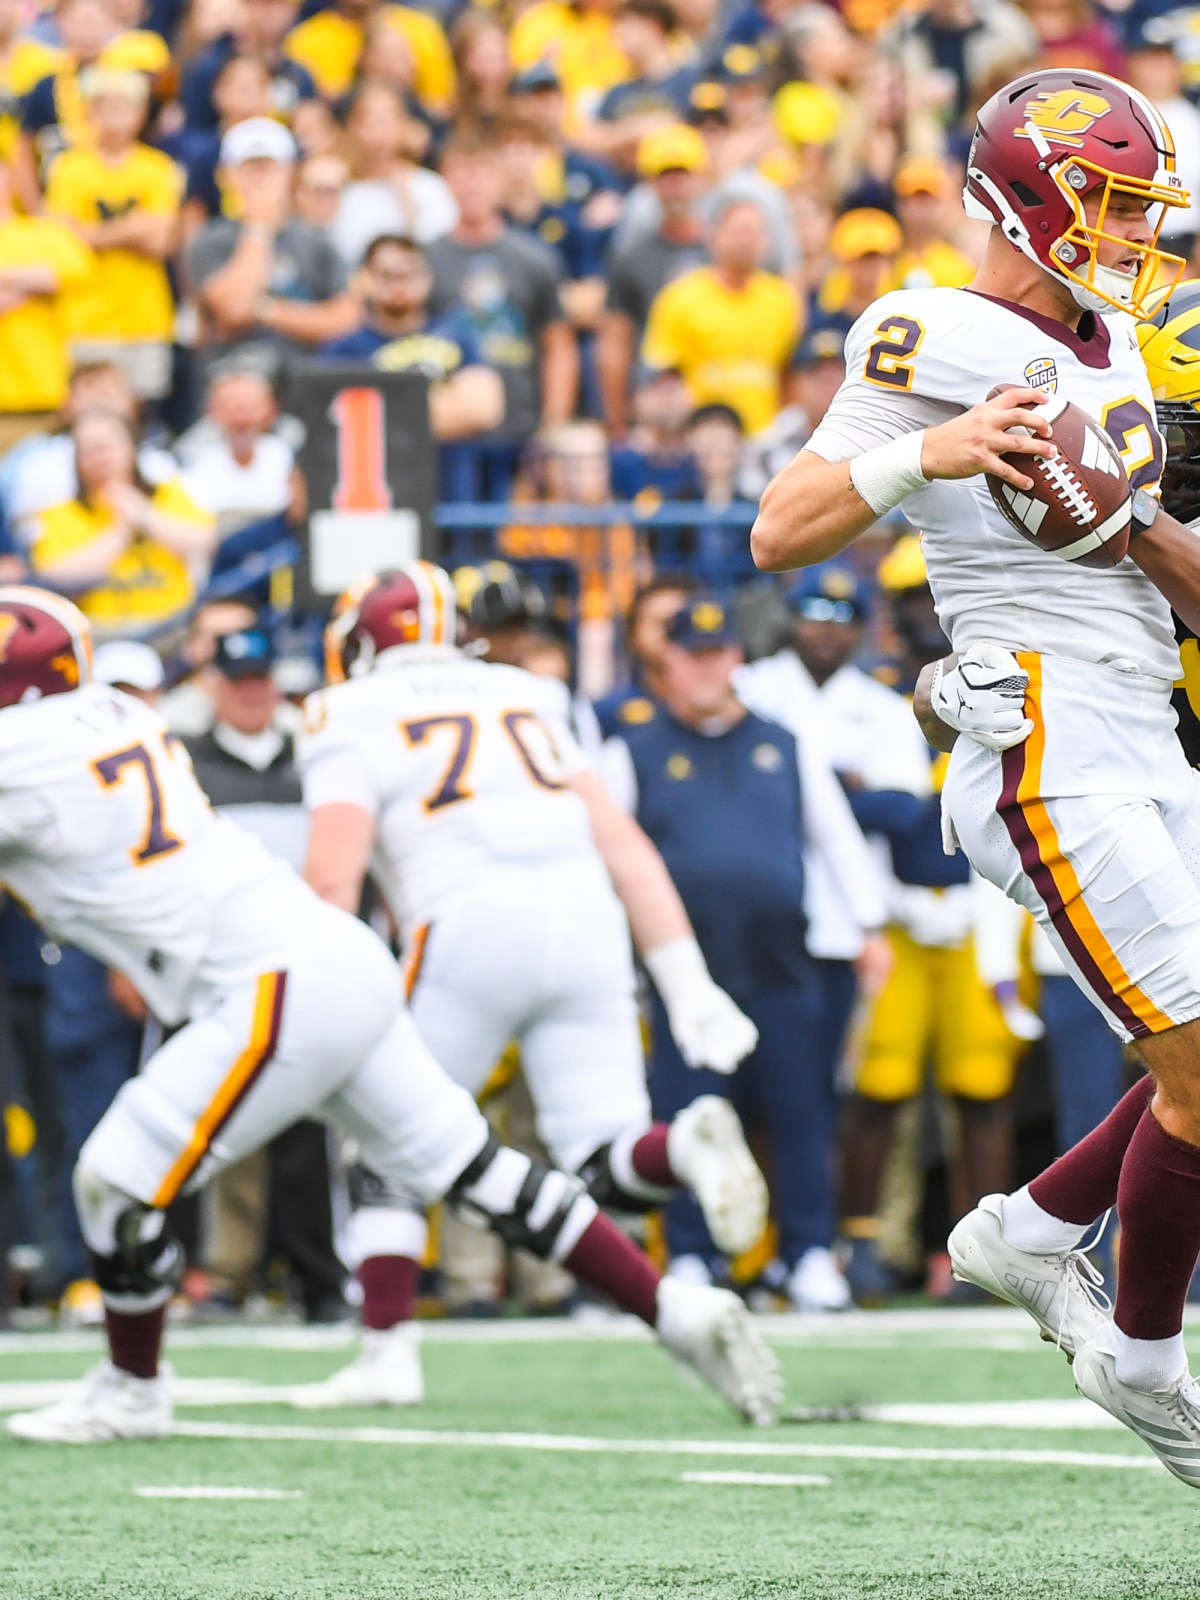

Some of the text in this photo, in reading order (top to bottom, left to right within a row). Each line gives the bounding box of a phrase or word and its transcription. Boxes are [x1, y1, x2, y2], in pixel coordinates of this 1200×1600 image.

[863, 313, 926, 392] 2
[1027, 367, 1057, 388] MAC
[328, 386, 392, 514] 1
[396, 708, 574, 816] 70
